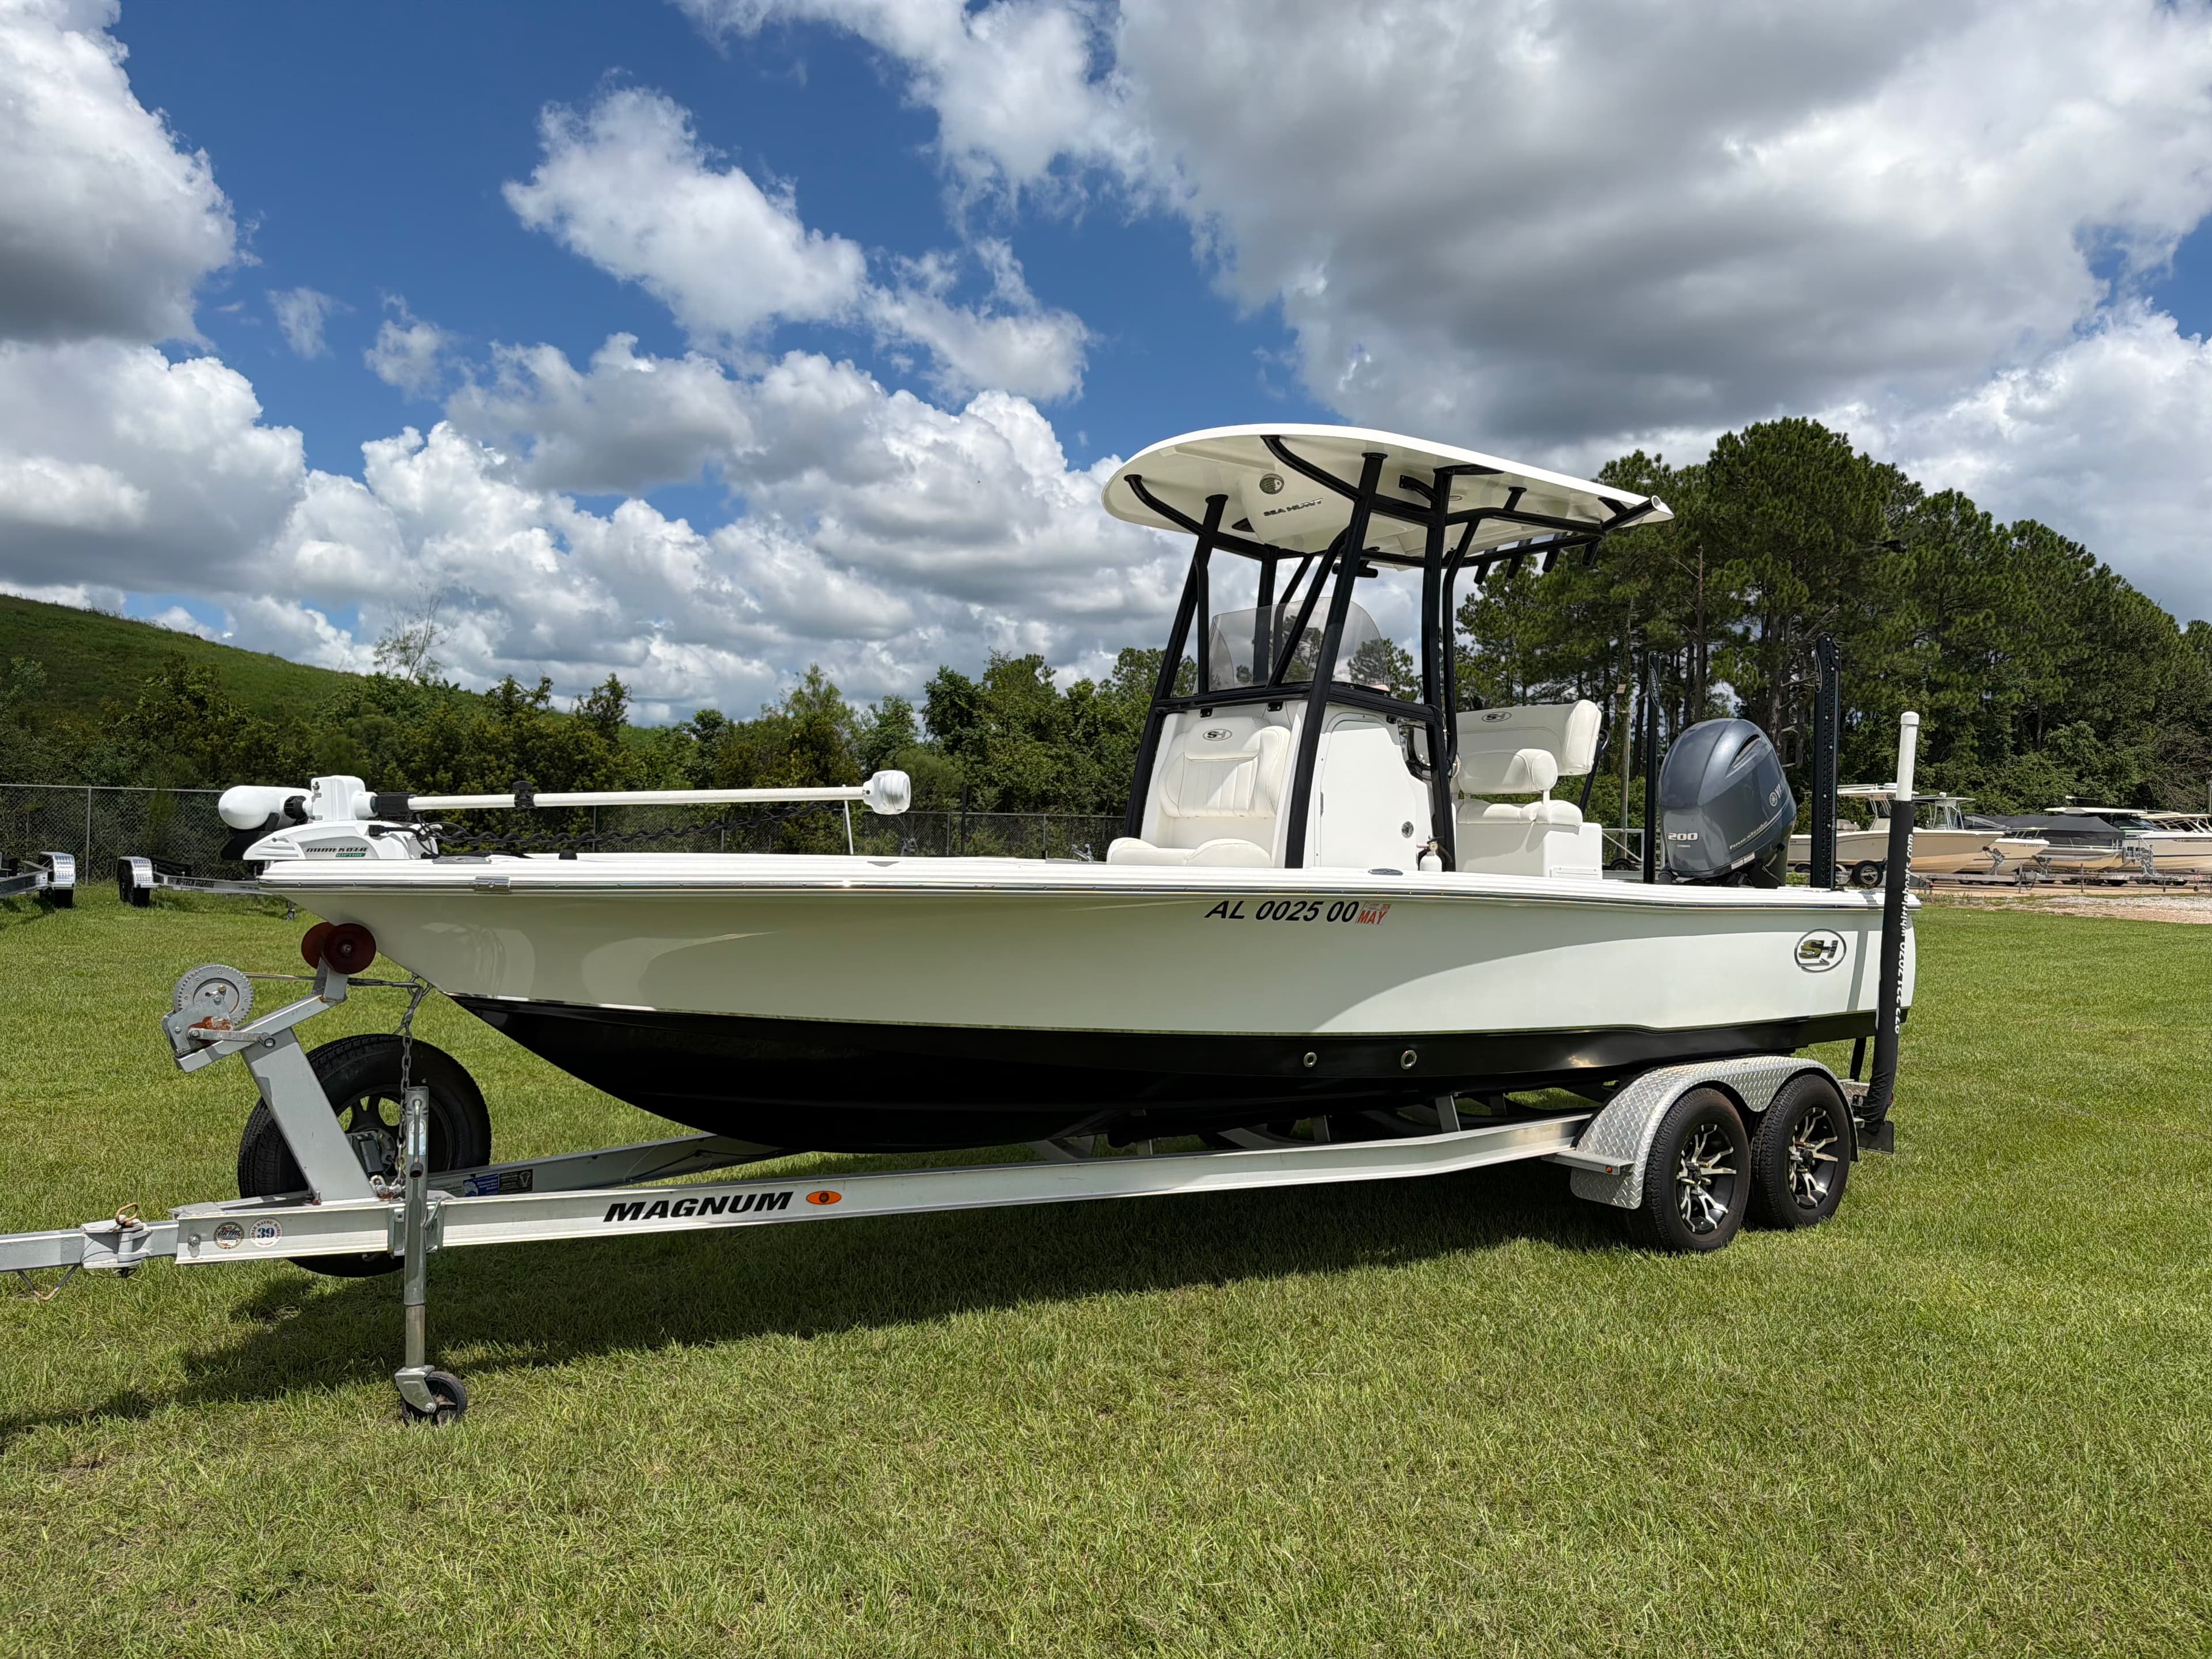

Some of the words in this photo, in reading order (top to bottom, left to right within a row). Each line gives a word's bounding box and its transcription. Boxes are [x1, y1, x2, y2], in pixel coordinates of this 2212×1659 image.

[1263, 508, 1286, 516] SEA
[1668, 832, 1699, 841] 200
[1900, 834, 1914, 937] whittleboatscom
[1204, 900, 1245, 919] AL
[1255, 900, 1324, 922] 0025
[1326, 901, 1359, 923] 00
[1357, 910, 1387, 925] MAY
[1798, 939, 1839, 959] SH
[603, 1191, 794, 1222] MAGNUM
[257, 1228, 275, 1238] 39
